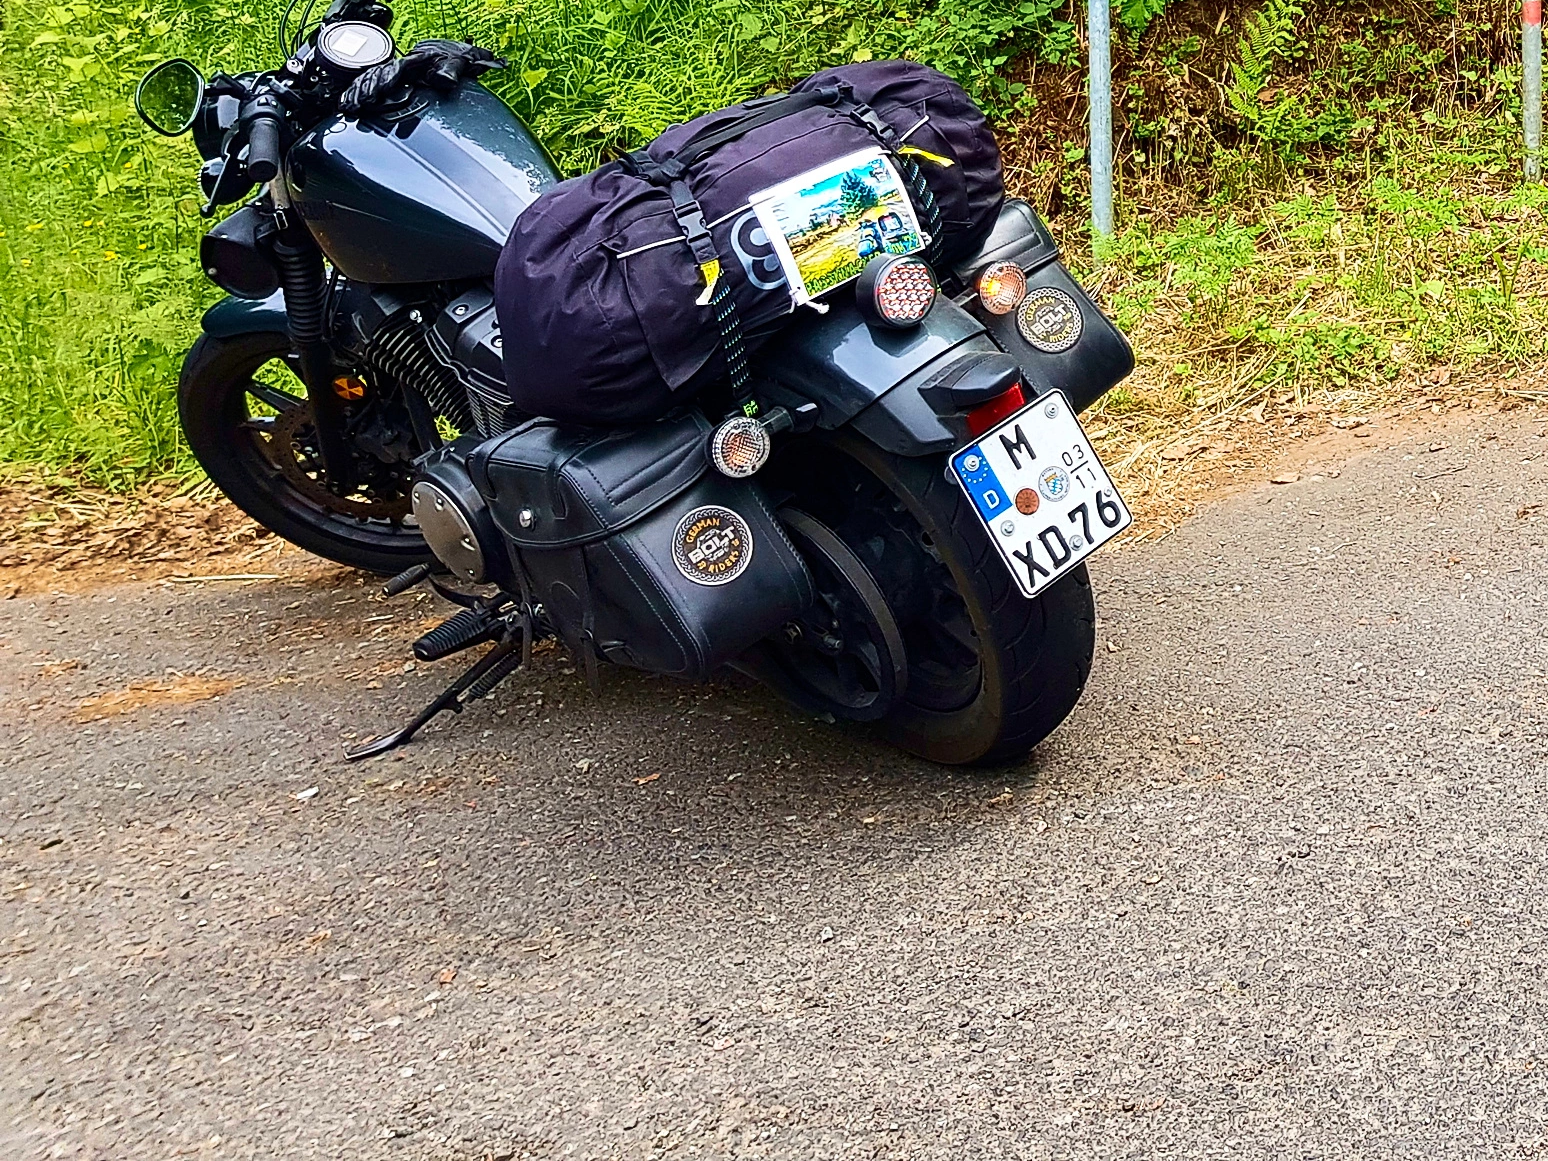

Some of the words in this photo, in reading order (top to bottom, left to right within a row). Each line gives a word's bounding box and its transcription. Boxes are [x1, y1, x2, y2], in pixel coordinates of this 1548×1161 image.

[1026, 297, 1056, 321] GERMAN
[1030, 304, 1068, 335] BOLT
[1049, 322, 1074, 343] RIDERS
[999, 424, 1037, 470] M
[1061, 444, 1084, 467] 03
[1075, 468, 1097, 489] 11
[982, 489, 1000, 509] D
[685, 517, 720, 543] GERMAN
[688, 526, 735, 564] BOLT
[708, 550, 740, 574] RIDERS
